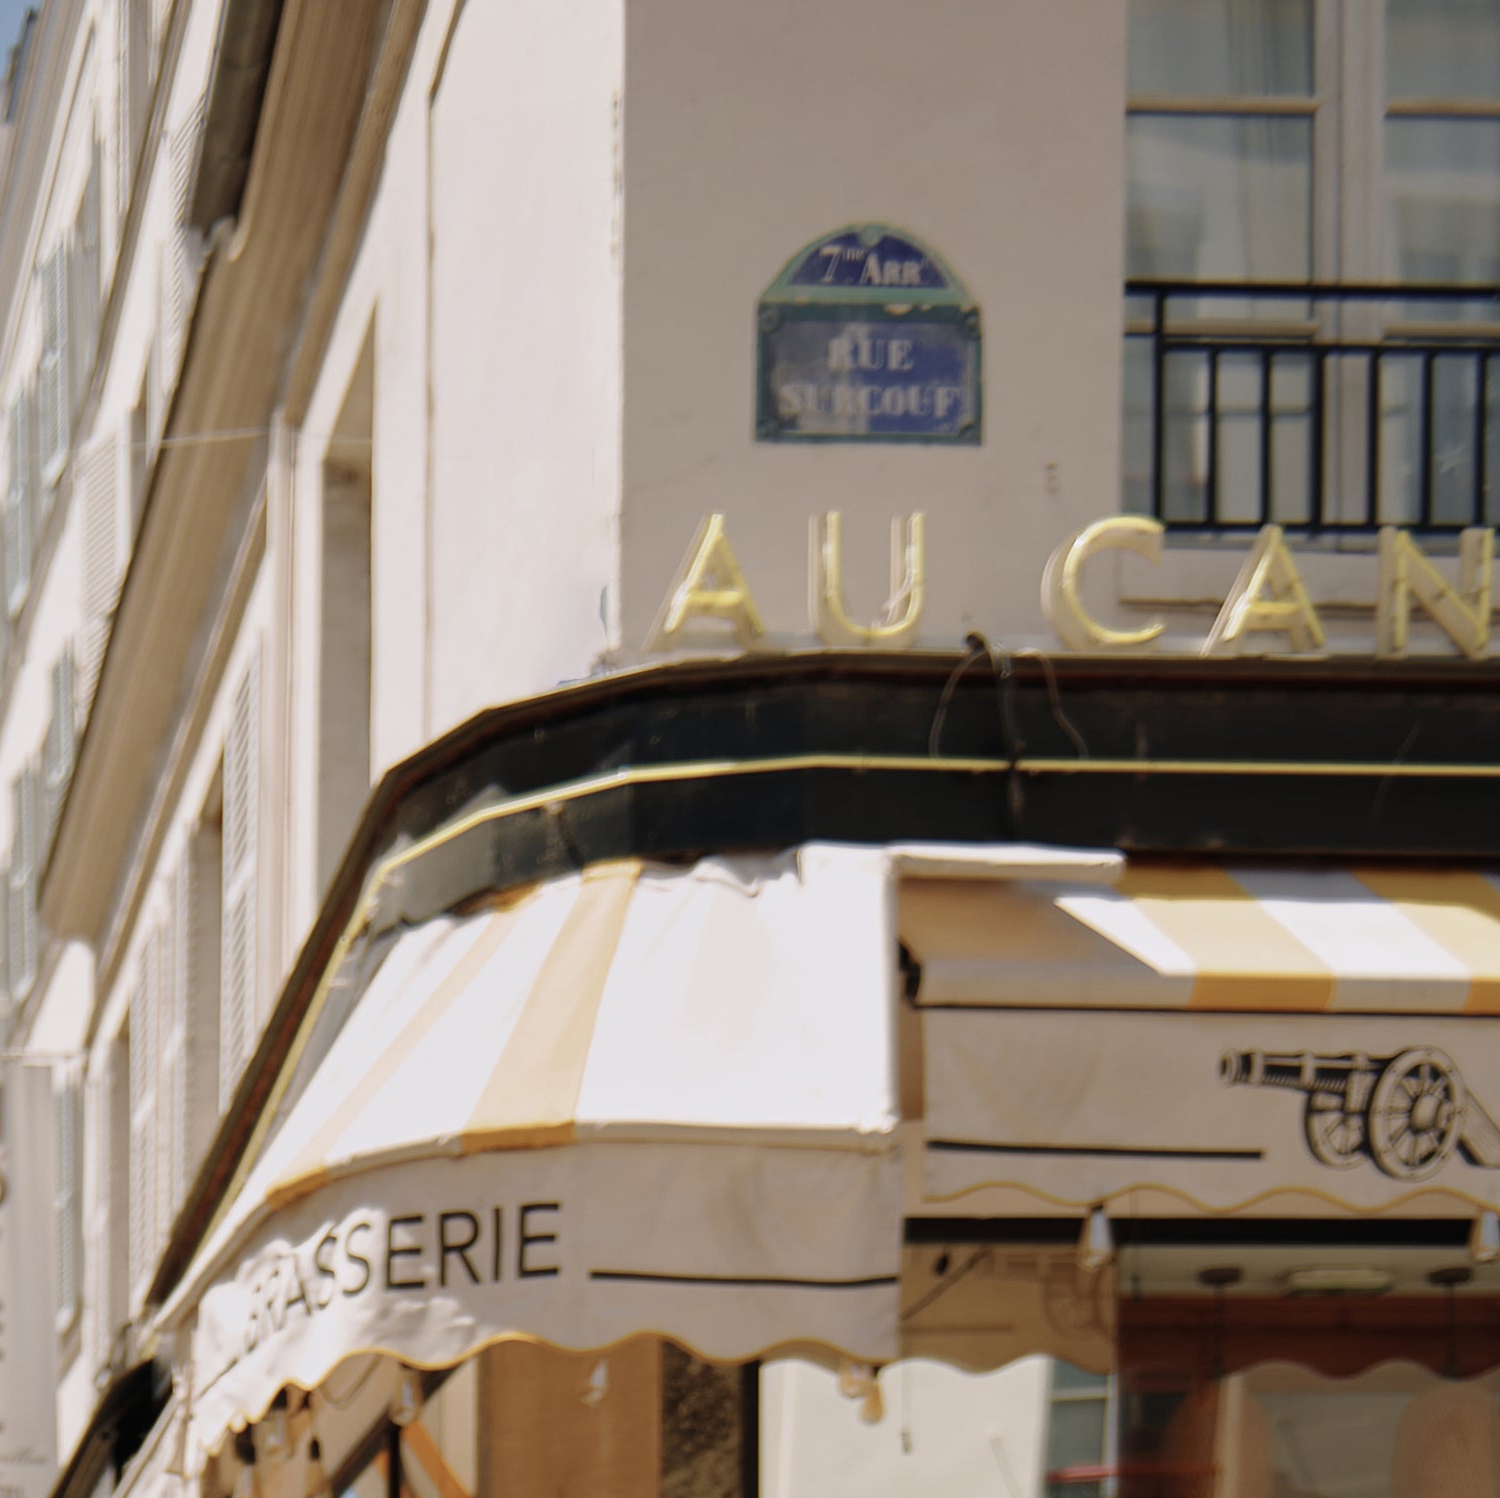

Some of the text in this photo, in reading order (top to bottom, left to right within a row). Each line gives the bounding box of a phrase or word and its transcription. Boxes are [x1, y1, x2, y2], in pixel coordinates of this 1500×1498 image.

[826, 339, 916, 371] RUE
[777, 385, 962, 419] SURCOUF
[643, 511, 1498, 659] AU CAN
[242, 1201, 562, 1354] BRASSERIE
